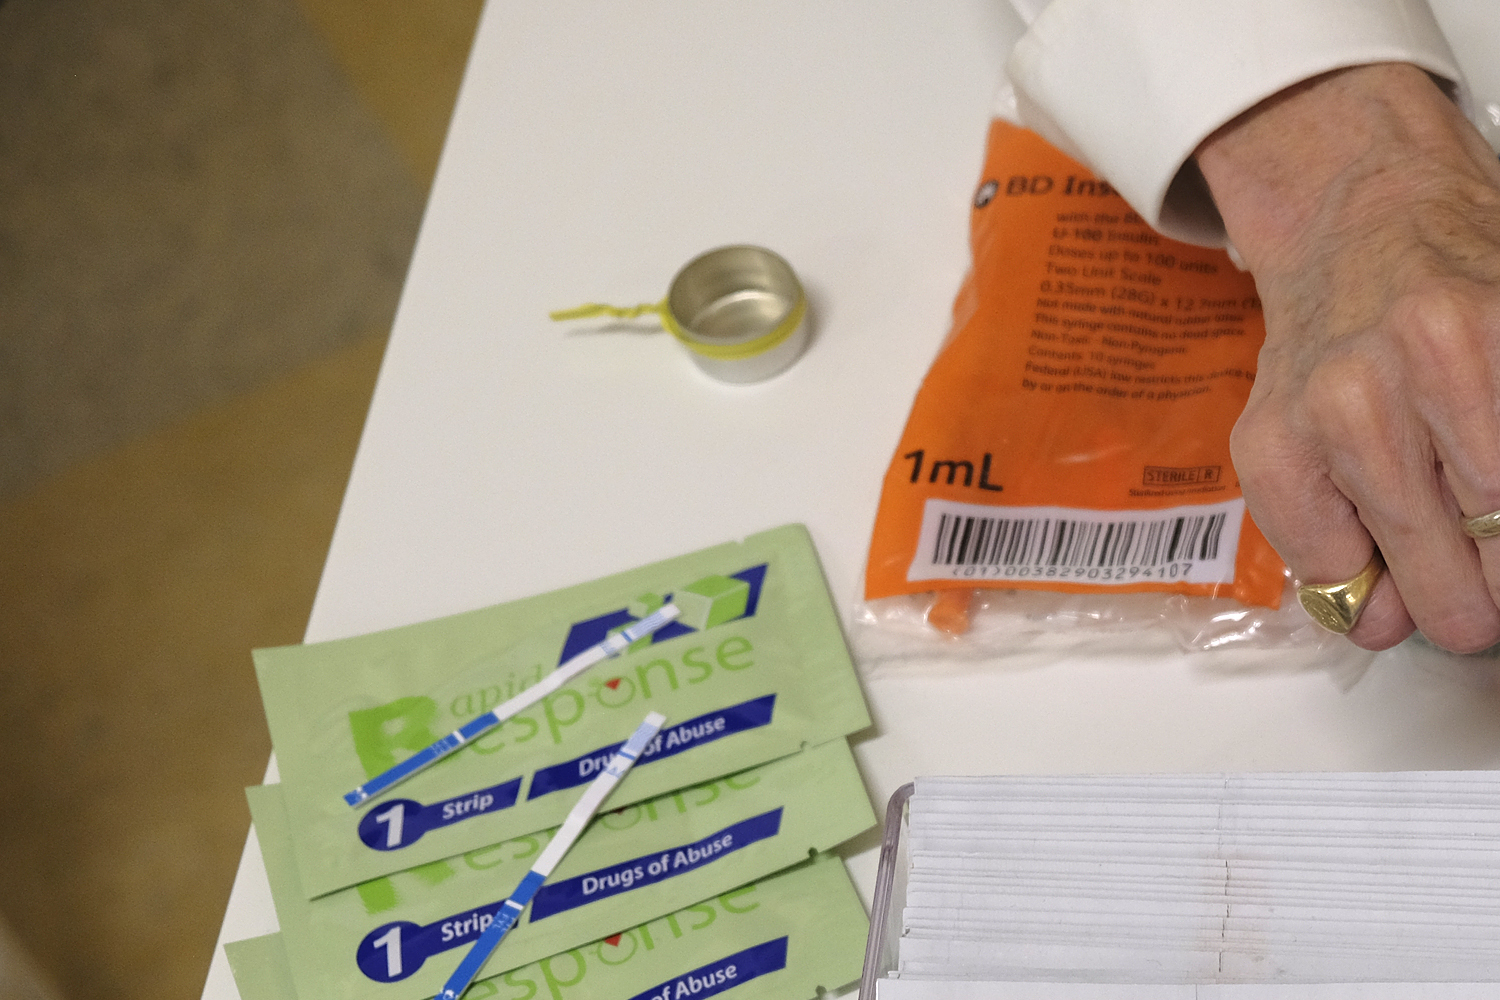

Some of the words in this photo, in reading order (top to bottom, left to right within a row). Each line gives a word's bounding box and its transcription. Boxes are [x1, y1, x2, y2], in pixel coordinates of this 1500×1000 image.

[1006, 175, 1053, 196] BD
[1063, 177, 1120, 196] Ins
[904, 448, 1004, 492] 1mL
[1147, 470, 1195, 481] STERILE
[666, 715, 726, 748] Abuse
[375, 804, 405, 848] 1
[442, 793, 494, 820] Strip
[581, 866, 644, 896] Drugs
[648, 854, 670, 877] of
[673, 833, 734, 868] Abuse
[373, 926, 403, 978] 1
[441, 911, 494, 942] Strip
[675, 963, 738, 999] Abuse
